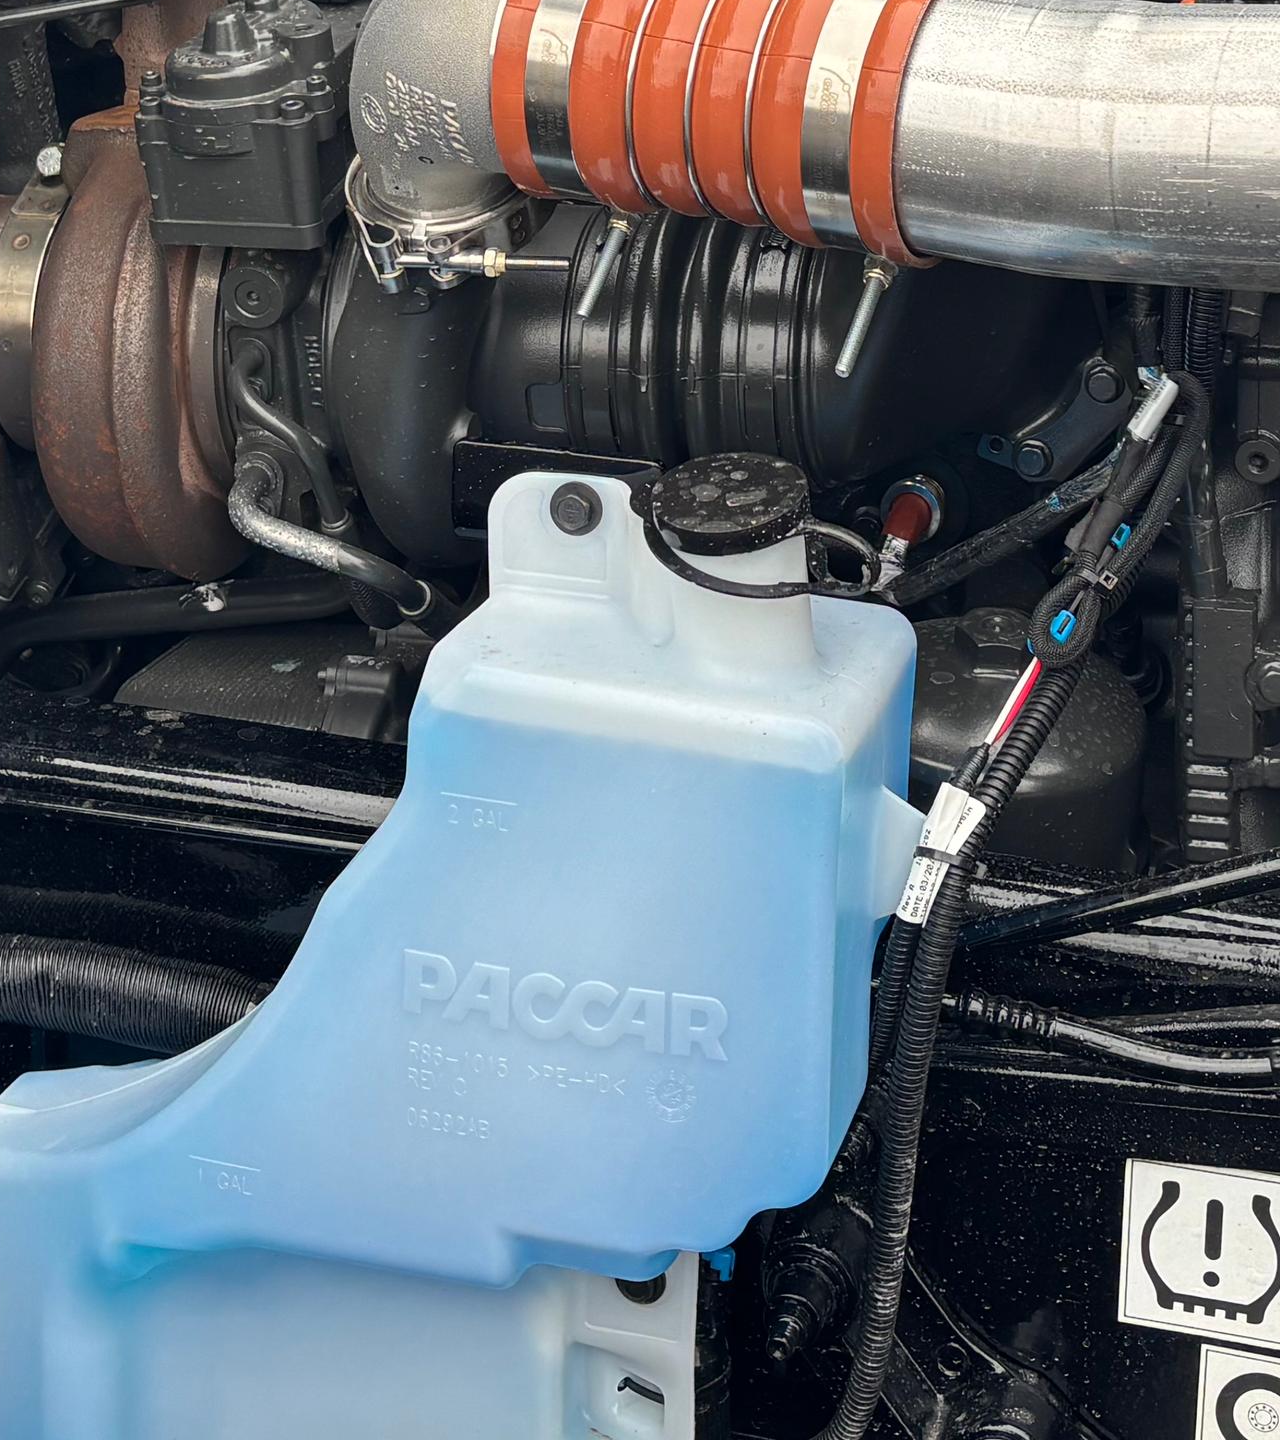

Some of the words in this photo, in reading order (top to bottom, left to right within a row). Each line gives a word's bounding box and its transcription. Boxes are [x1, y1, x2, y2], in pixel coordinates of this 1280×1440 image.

[472, 808, 509, 832] GAL
[901, 896, 911, 912] Rev
[403, 947, 728, 1061] PACCAR
[217, 1171, 253, 1195] GAL
